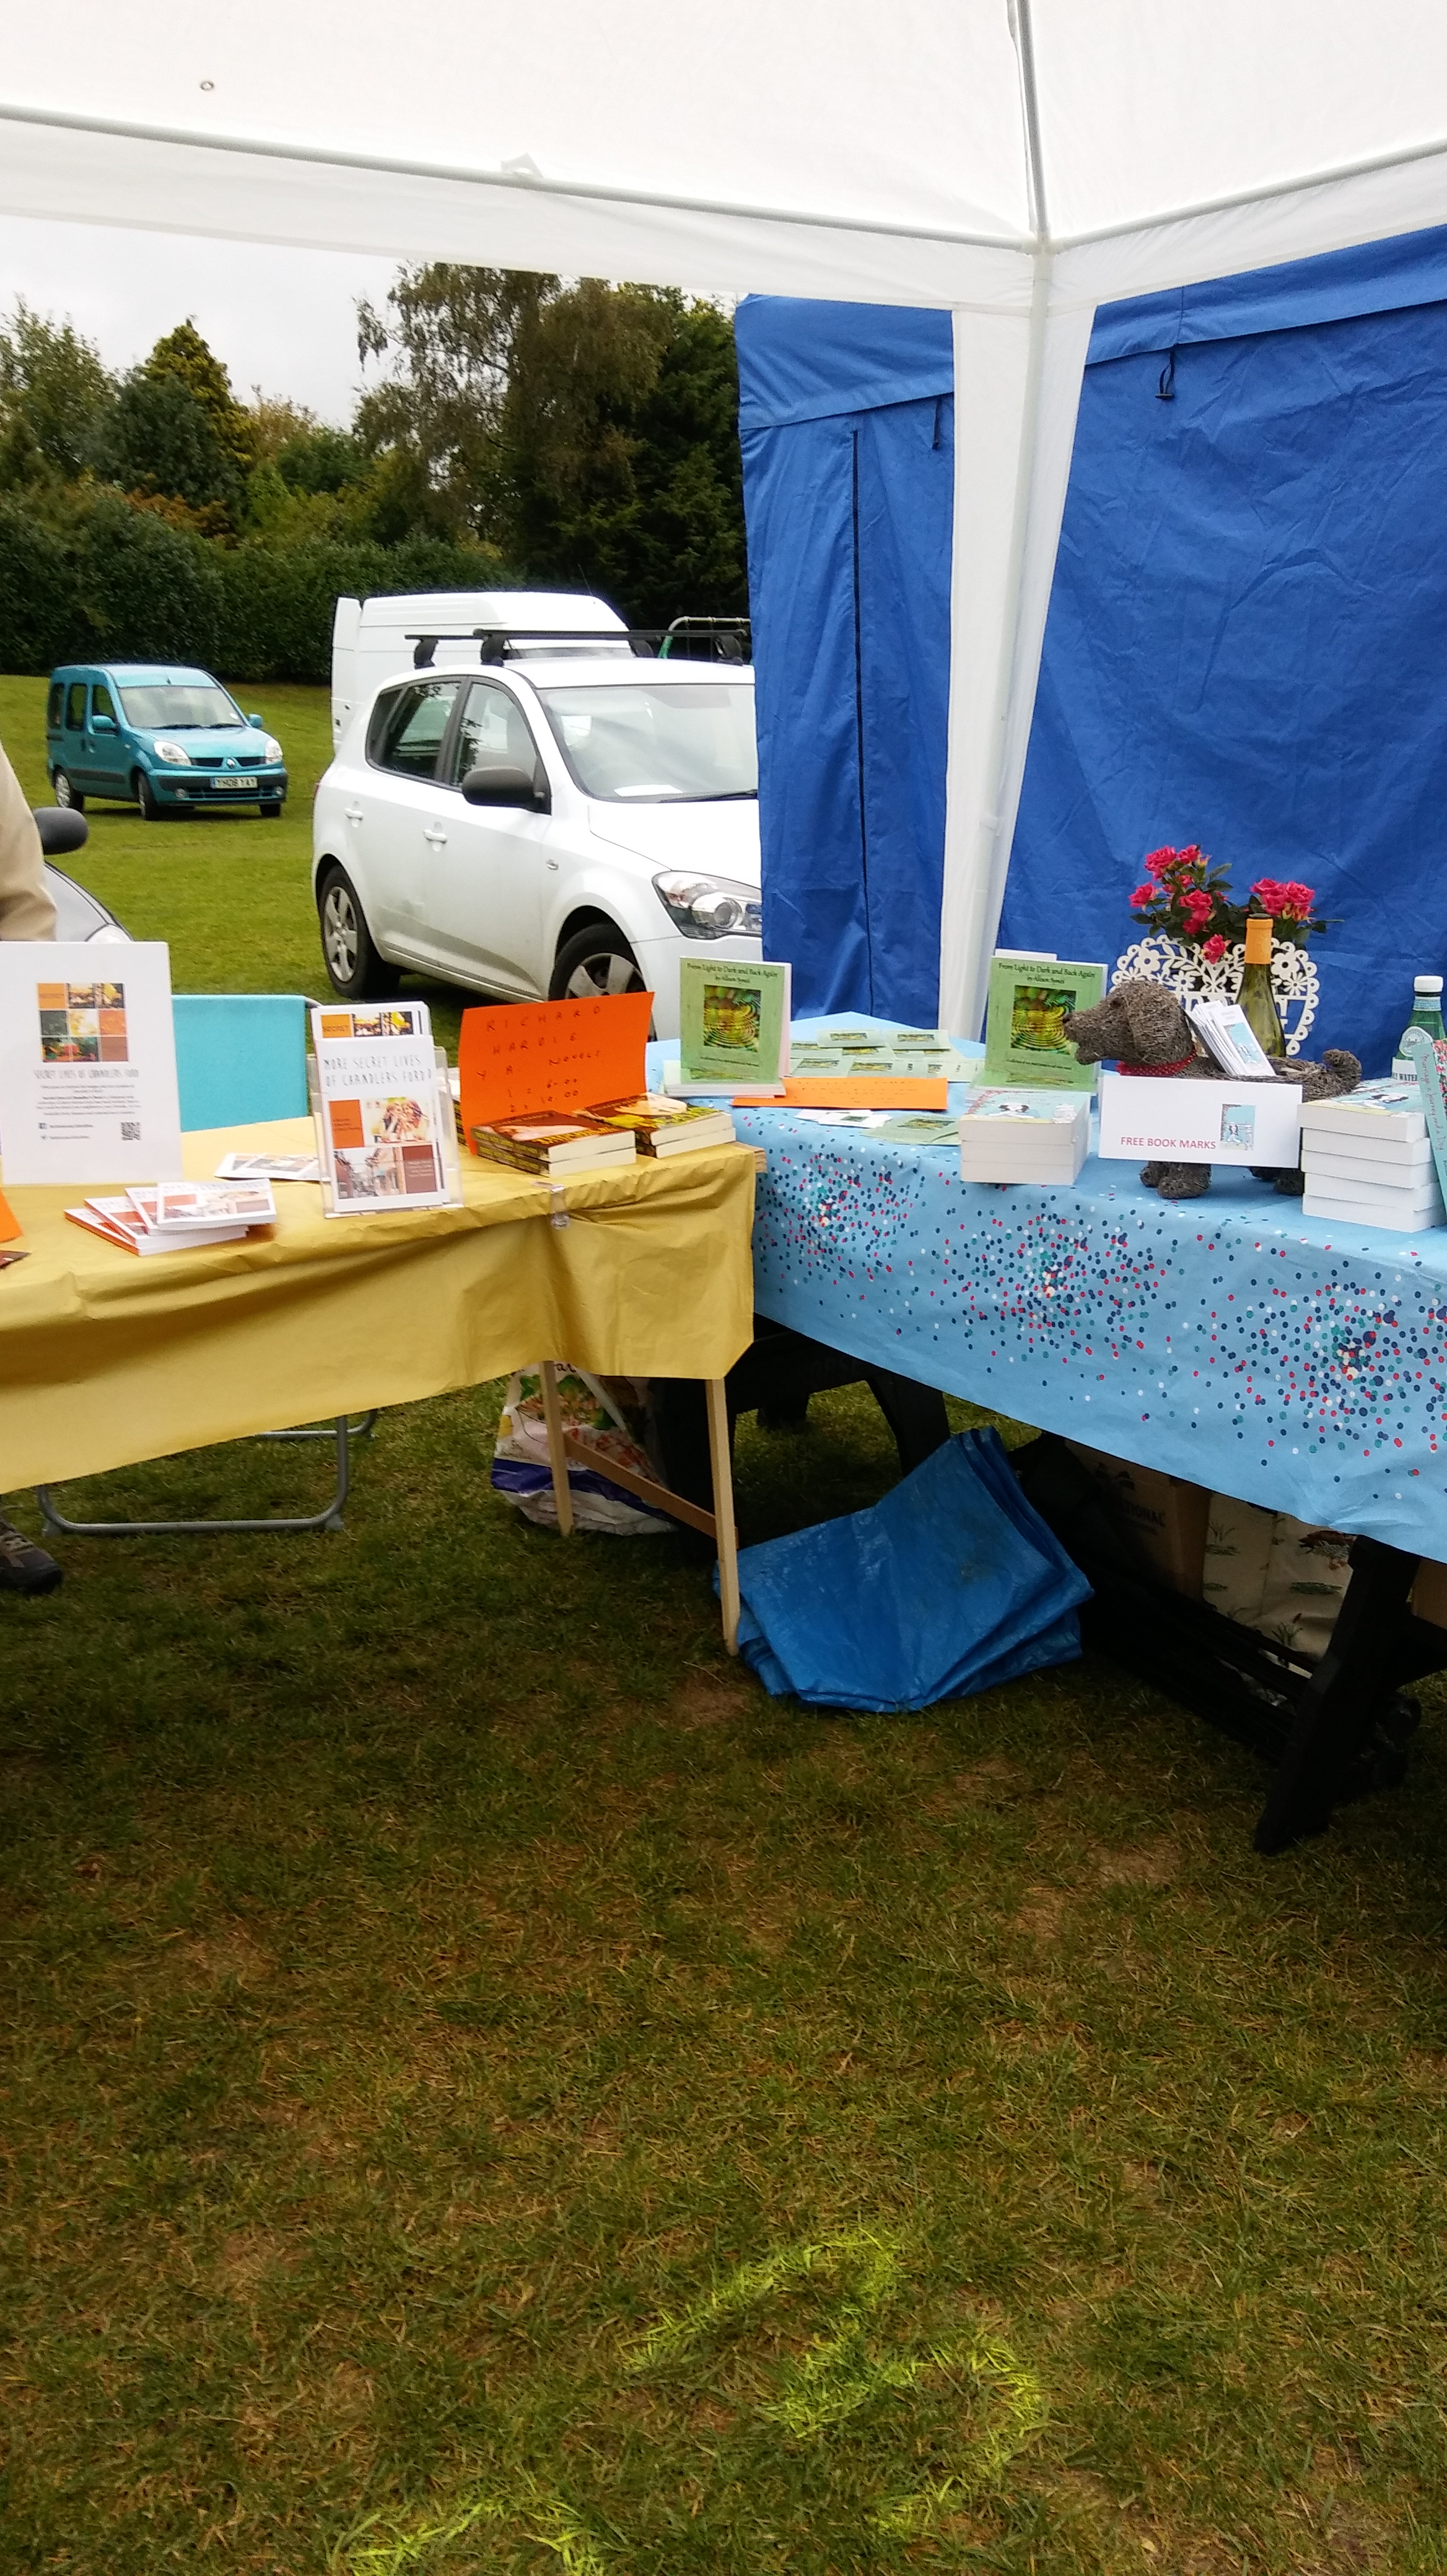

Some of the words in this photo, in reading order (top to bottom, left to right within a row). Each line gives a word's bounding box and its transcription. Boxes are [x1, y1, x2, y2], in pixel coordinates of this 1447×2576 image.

[702, 964, 716, 973] Light
[763, 970, 778, 979] Again
[1014, 964, 1029, 973] Light
[1036, 965, 1050, 973] Dark
[1078, 970, 1095, 980] Again
[486, 1006, 600, 1032] RICHARD
[323, 1058, 347, 1070] MORE
[353, 1056, 387, 1069] SECRET
[394, 1055, 421, 1067] LIVES
[325, 1075, 336, 1087] OF
[343, 1071, 397, 1086] CHANDLERS
[1121, 1137, 1144, 1146] FREE
[1147, 1138, 1177, 1147] BOOK
[1179, 1139, 1216, 1150] MARKS
